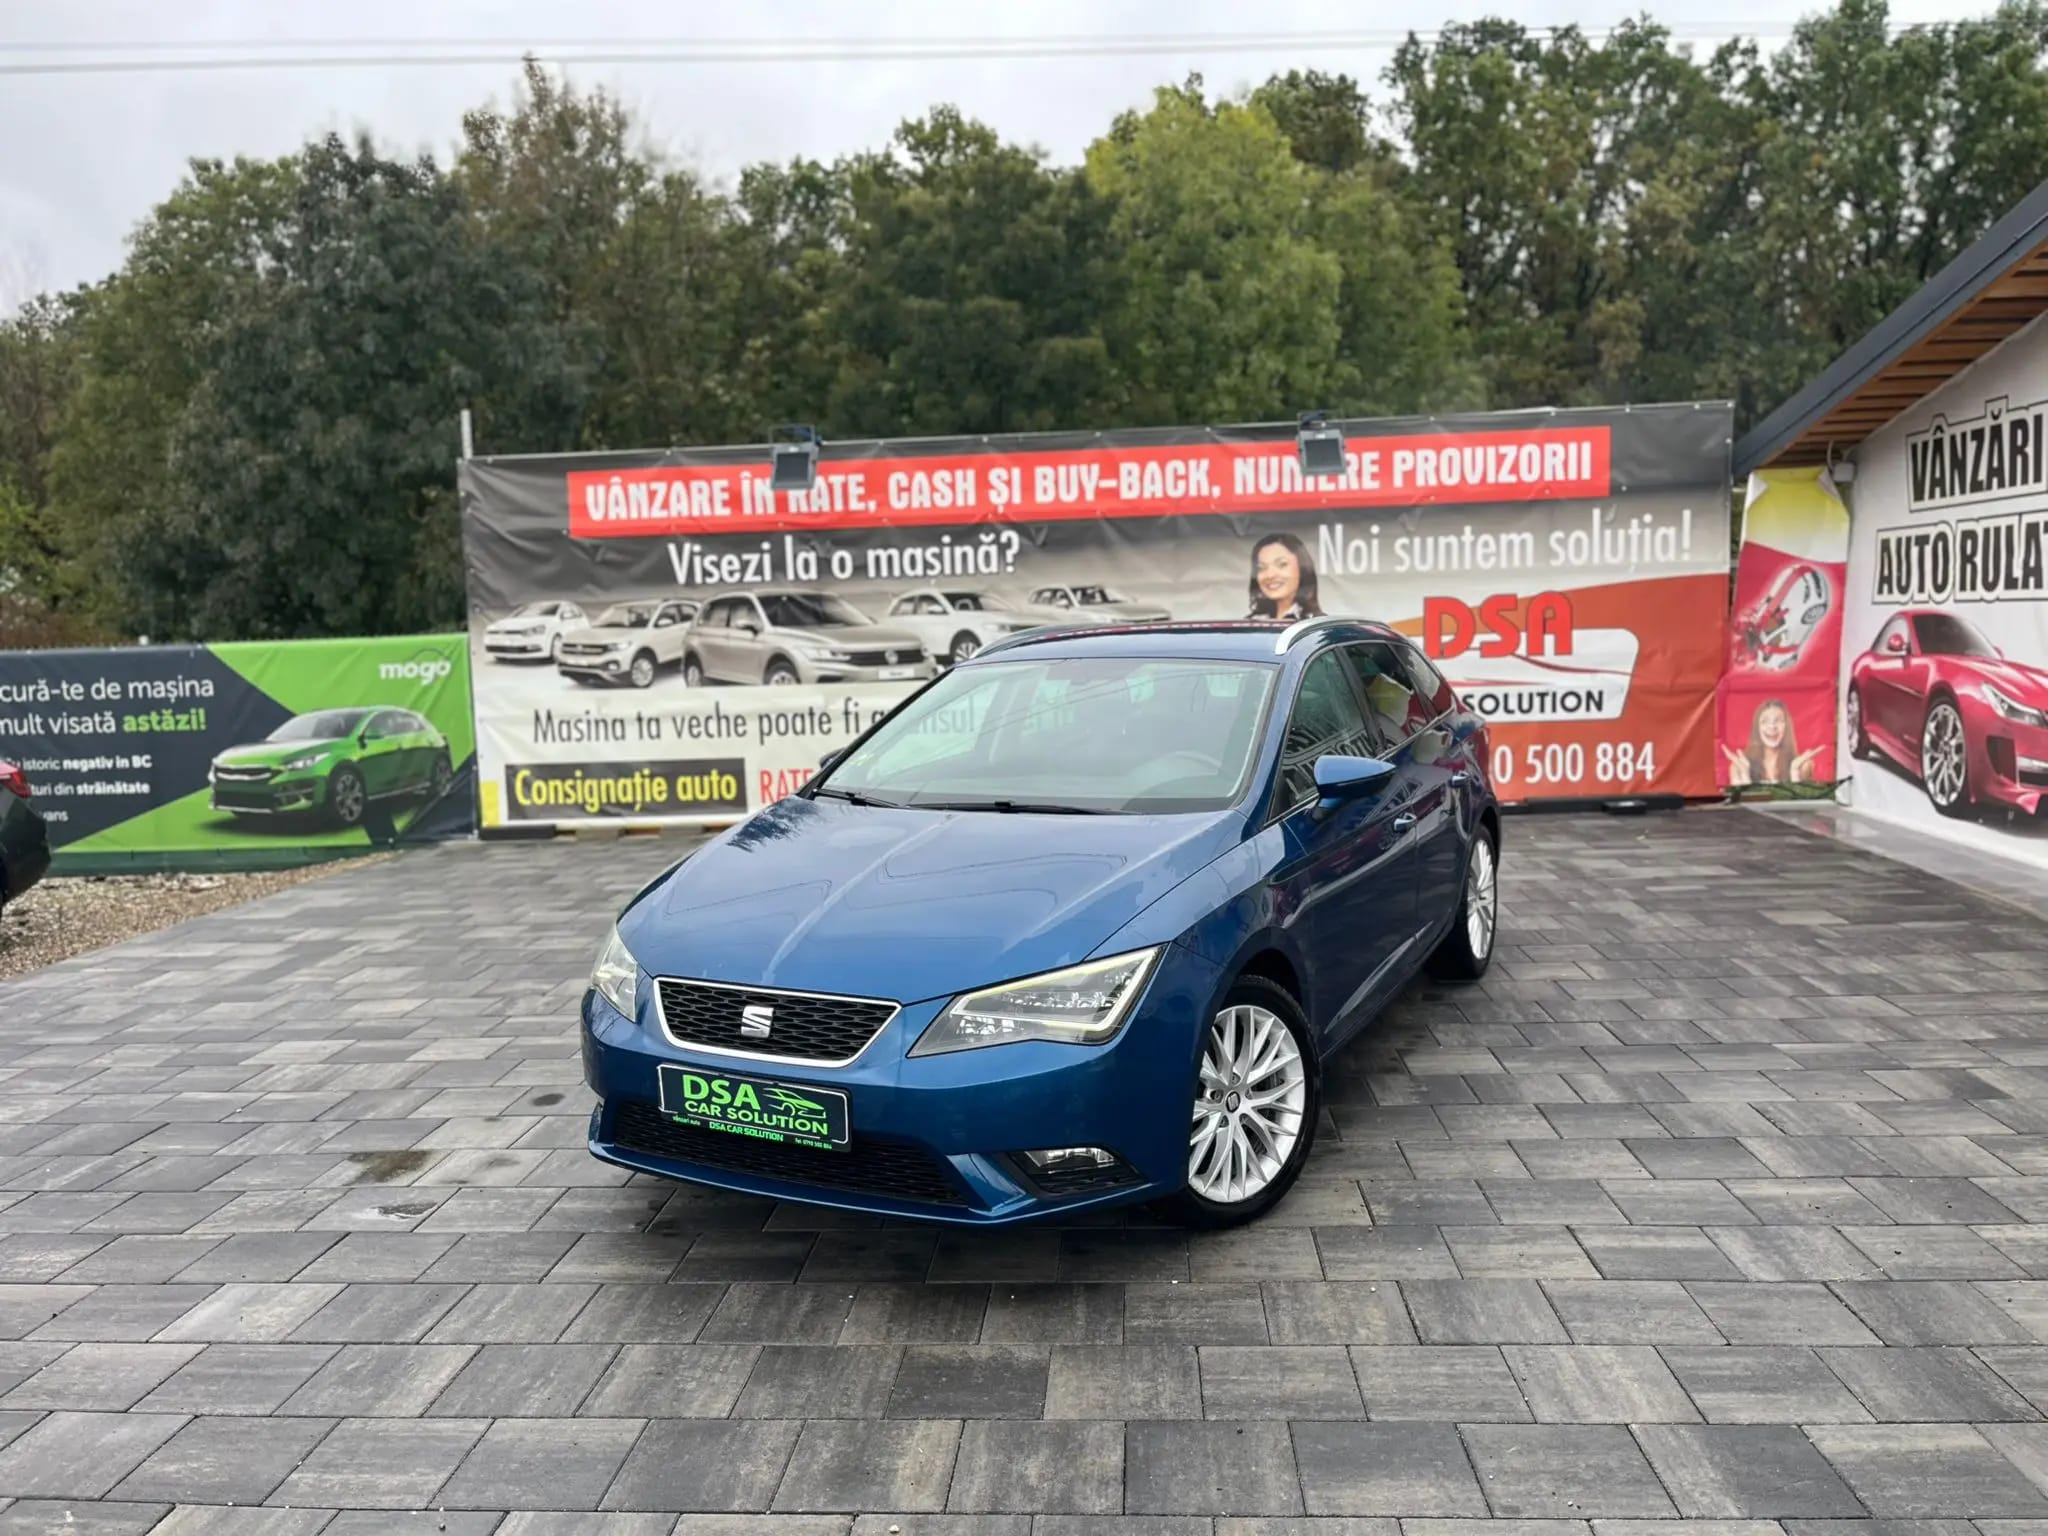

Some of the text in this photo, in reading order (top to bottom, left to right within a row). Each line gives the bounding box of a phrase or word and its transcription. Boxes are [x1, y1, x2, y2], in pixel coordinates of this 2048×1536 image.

[1911, 408, 2043, 502] VÂNZĂRI
[585, 476, 731, 521] VÂNZARE
[740, 471, 776, 516] ÎN
[888, 469, 976, 510] CASH
[988, 466, 1021, 515] ȘI
[1035, 458, 1221, 504] BUY-BACK,
[1393, 441, 1592, 489] PROVIZORII
[667, 541, 772, 585] Visezi
[785, 534, 818, 581] la
[831, 549, 852, 580] o
[1318, 507, 1692, 575] Noi suntem soluția!
[1877, 521, 2048, 596] AUTO RULA
[1423, 590, 1573, 660] DSA
[90, 678, 121, 700] de
[128, 675, 214, 703] mașina
[378, 660, 451, 686] mogo
[49, 711, 116, 734] visată
[123, 708, 206, 733] astăzi!
[534, 708, 626, 743] Masina
[636, 711, 661, 740] ta
[672, 701, 747, 740] veche
[759, 704, 832, 746] poate
[844, 697, 860, 734] fi
[1462, 690, 1603, 716] SOLUTION
[23, 758, 60, 771] istoric
[62, 756, 113, 772] negativ
[131, 755, 152, 769] BC
[1525, 743, 1584, 783] 500
[1596, 742, 1655, 782] 884
[54, 781, 75, 795] din
[515, 768, 737, 813] Consignație auto
[683, 1074, 760, 1111] DSA
[685, 1101, 828, 1136] CAR SOLUTION
[709, 1121, 784, 1142] DSA CAR SOLUTION
